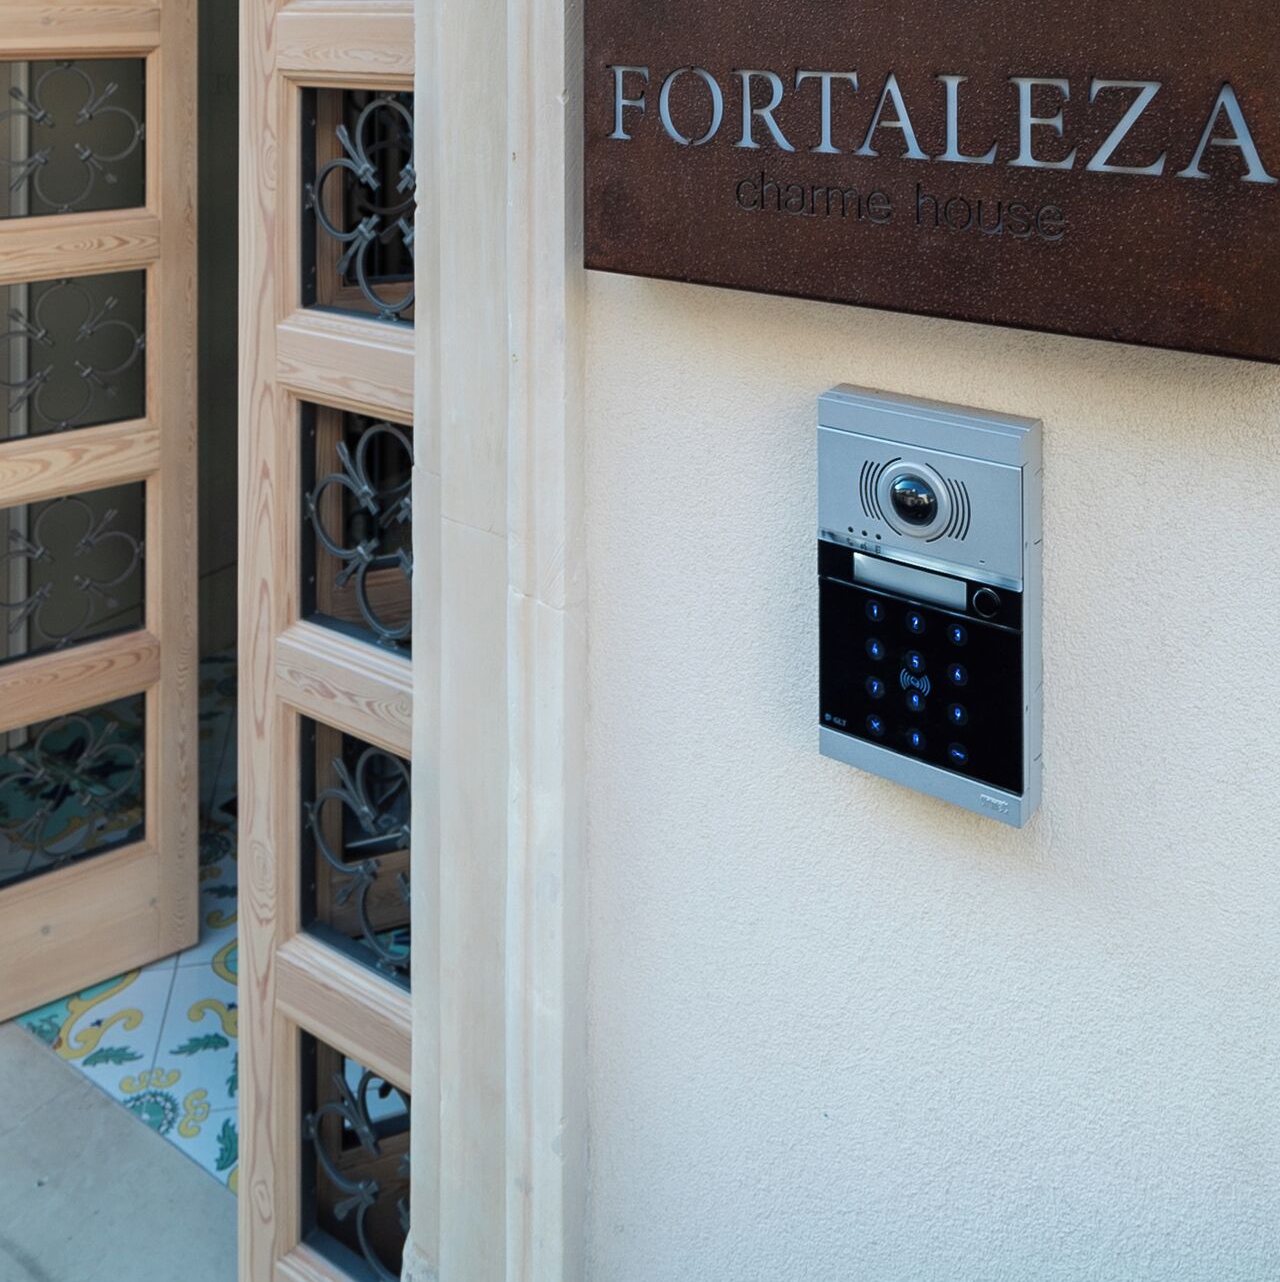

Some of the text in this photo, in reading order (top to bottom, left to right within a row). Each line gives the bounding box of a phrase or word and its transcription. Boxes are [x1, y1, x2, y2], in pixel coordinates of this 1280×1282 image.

[604, 63, 1280, 185] FORTALEZA
[735, 171, 1066, 241] charme house
